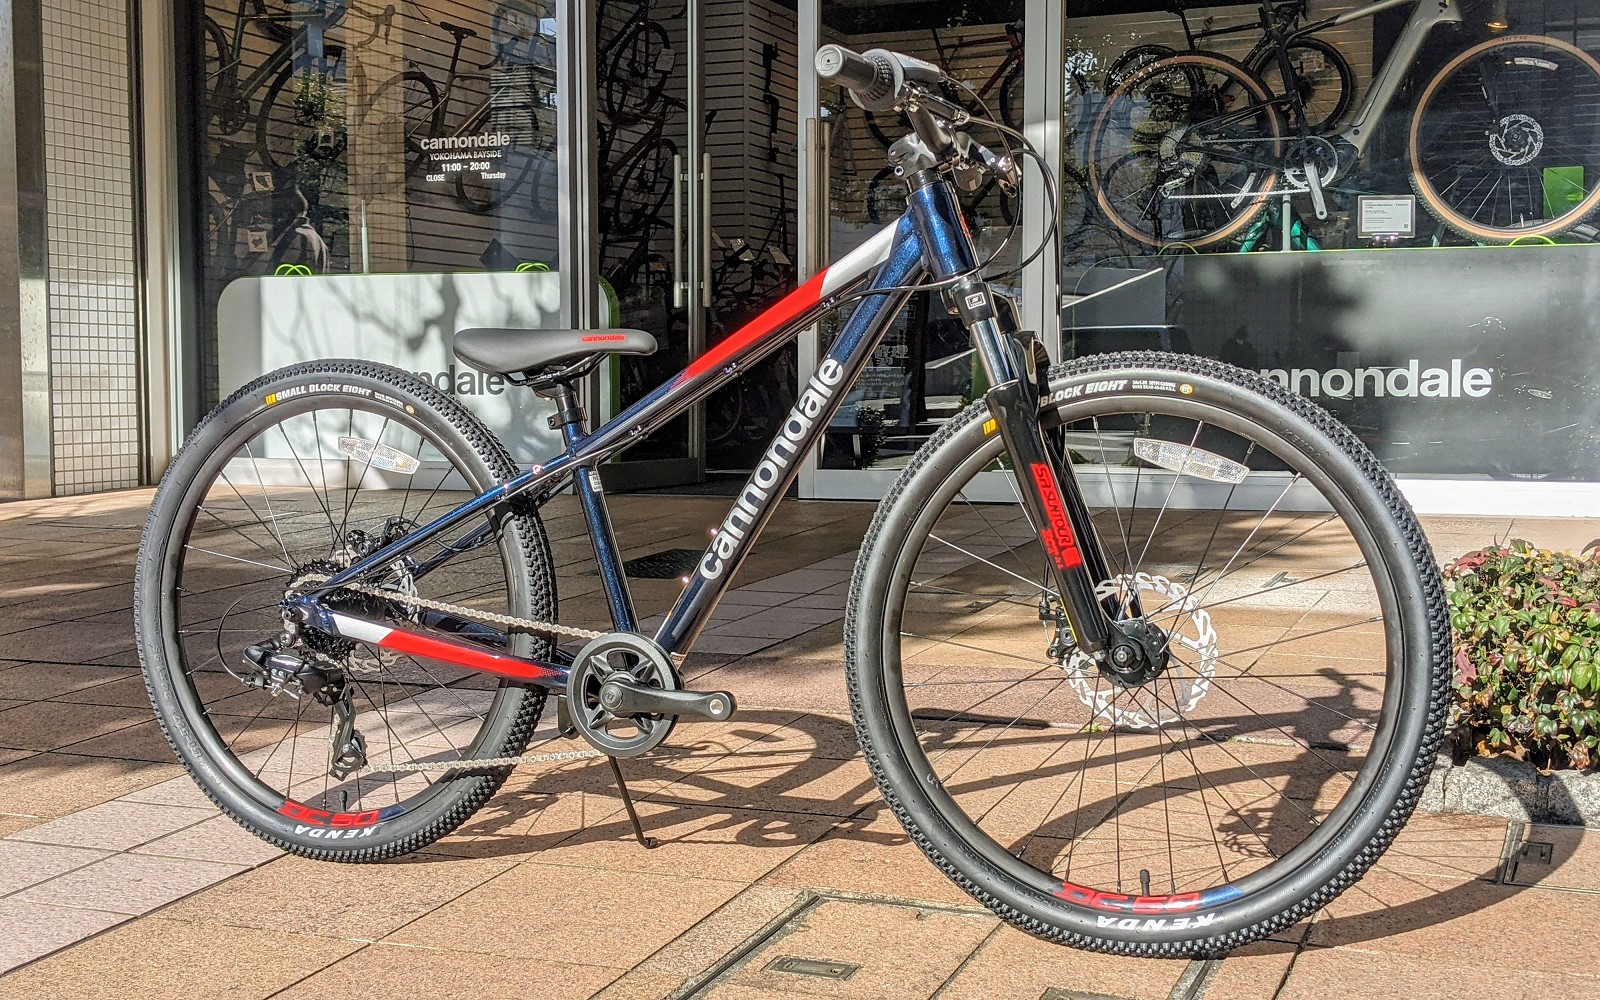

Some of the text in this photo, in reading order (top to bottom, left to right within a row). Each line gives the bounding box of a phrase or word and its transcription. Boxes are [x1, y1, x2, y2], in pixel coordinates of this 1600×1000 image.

[421, 131, 510, 150] cannondale
[430, 150, 502, 160] YOKOHAMA BAYSIDE
[441, 163, 461, 172] 11:00
[470, 161, 490, 171] 20:00
[426, 174, 445, 182] CLOSE
[480, 172, 506, 180] Thursday
[581, 333, 626, 342] cannondale
[1259, 358, 1492, 398] nnondale
[276, 383, 372, 401] SMALL BLOCK EIGHT
[1040, 379, 1128, 408] BLOCK EIGHT
[699, 356, 844, 580] cannondale
[1035, 467, 1052, 489] SR
[1043, 488, 1072, 545] SUNTOUR
[294, 824, 378, 839] KENDA
[1096, 912, 1216, 931] KENDA
